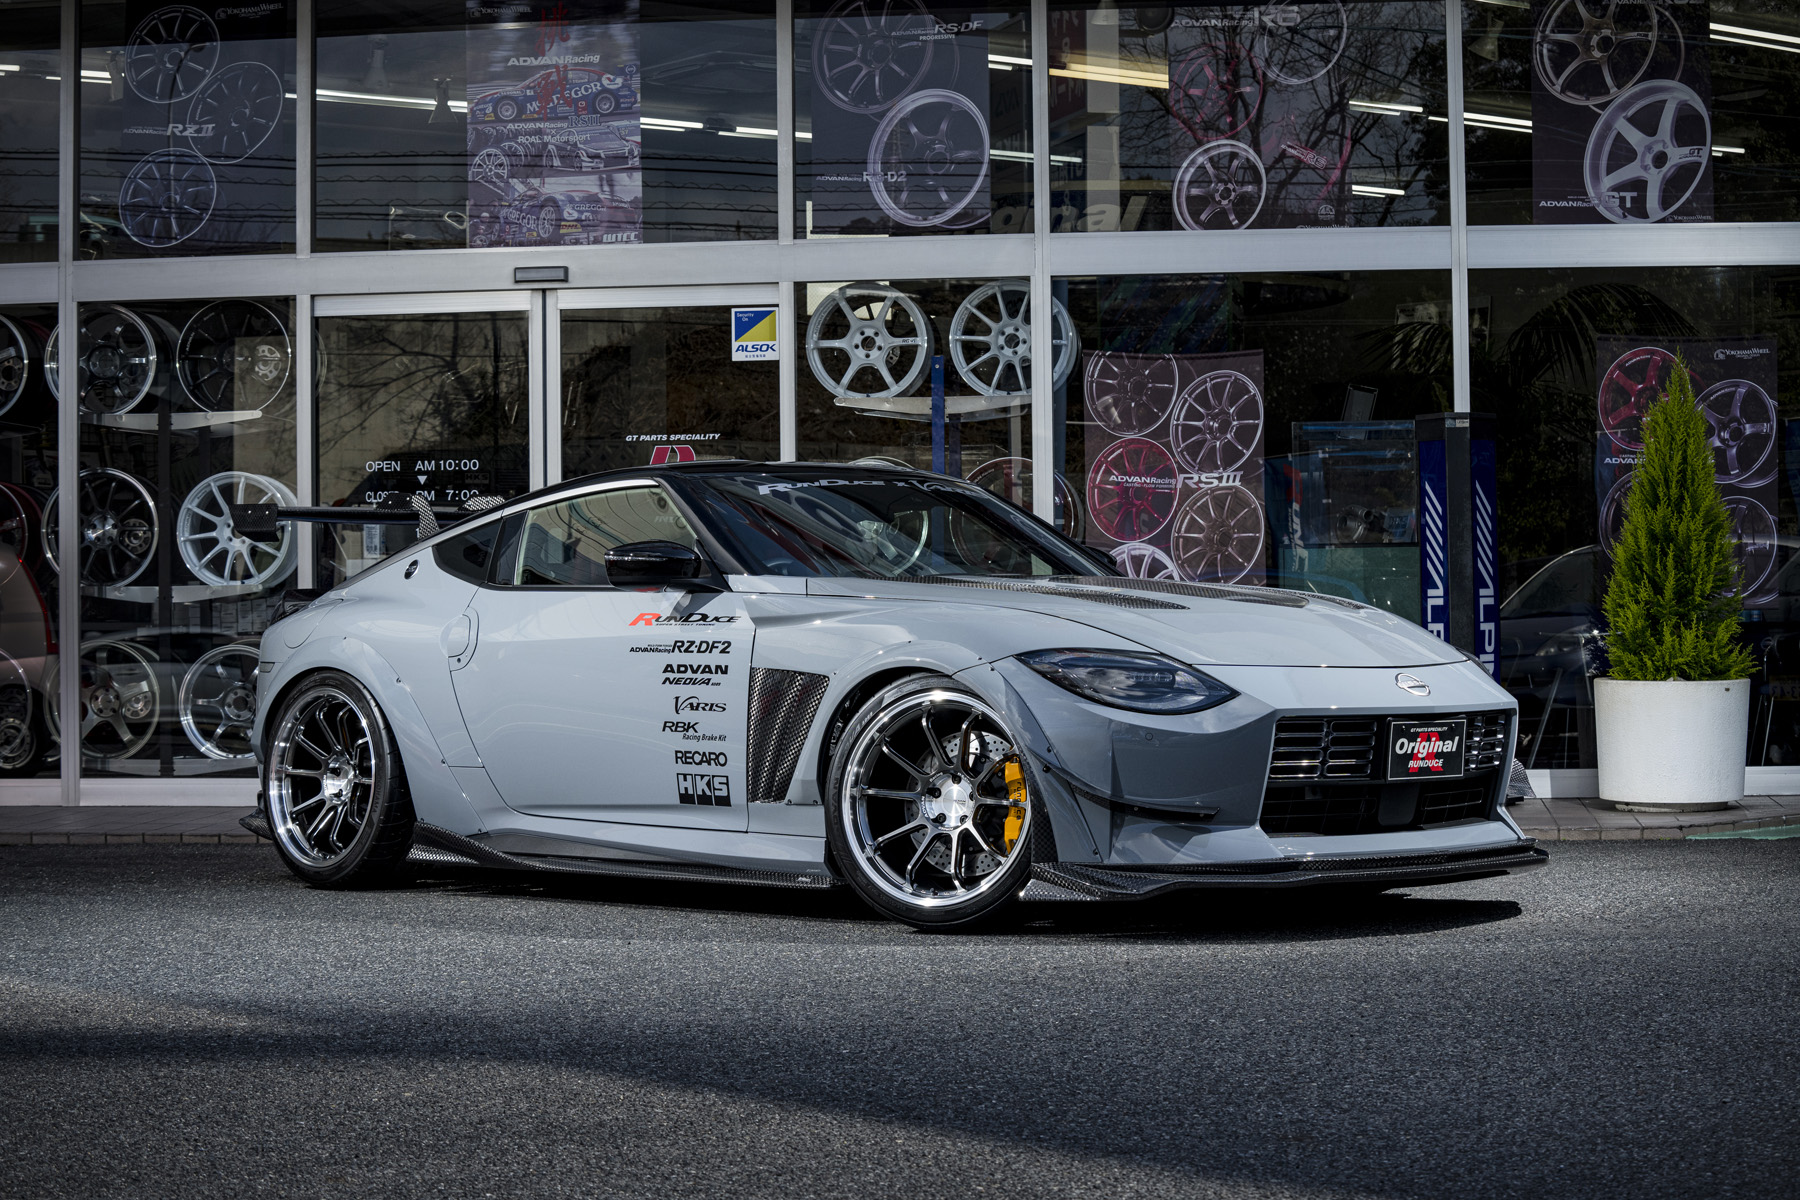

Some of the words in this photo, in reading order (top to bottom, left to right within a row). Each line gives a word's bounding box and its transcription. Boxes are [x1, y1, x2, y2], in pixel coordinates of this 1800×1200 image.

[735, 343, 777, 353] ALSOK
[625, 434, 639, 442] GT
[640, 434, 668, 442] PARTS
[669, 433, 721, 441] SPECIALITY
[365, 460, 401, 472] OPEN
[414, 460, 436, 471] AM
[439, 459, 480, 471] 10:00
[365, 490, 400, 503] CLOS
[662, 664, 729, 675] ADVAN
[662, 677, 713, 686] NEOVA
[662, 721, 700, 734] RBK
[682, 733, 701, 743] Racing
[701, 734, 718, 742] Brake
[1395, 736, 1459, 758] Original
[674, 750, 728, 767] RECARO
[1407, 759, 1444, 768] RUNDUCE
[677, 773, 731, 801] HKS
